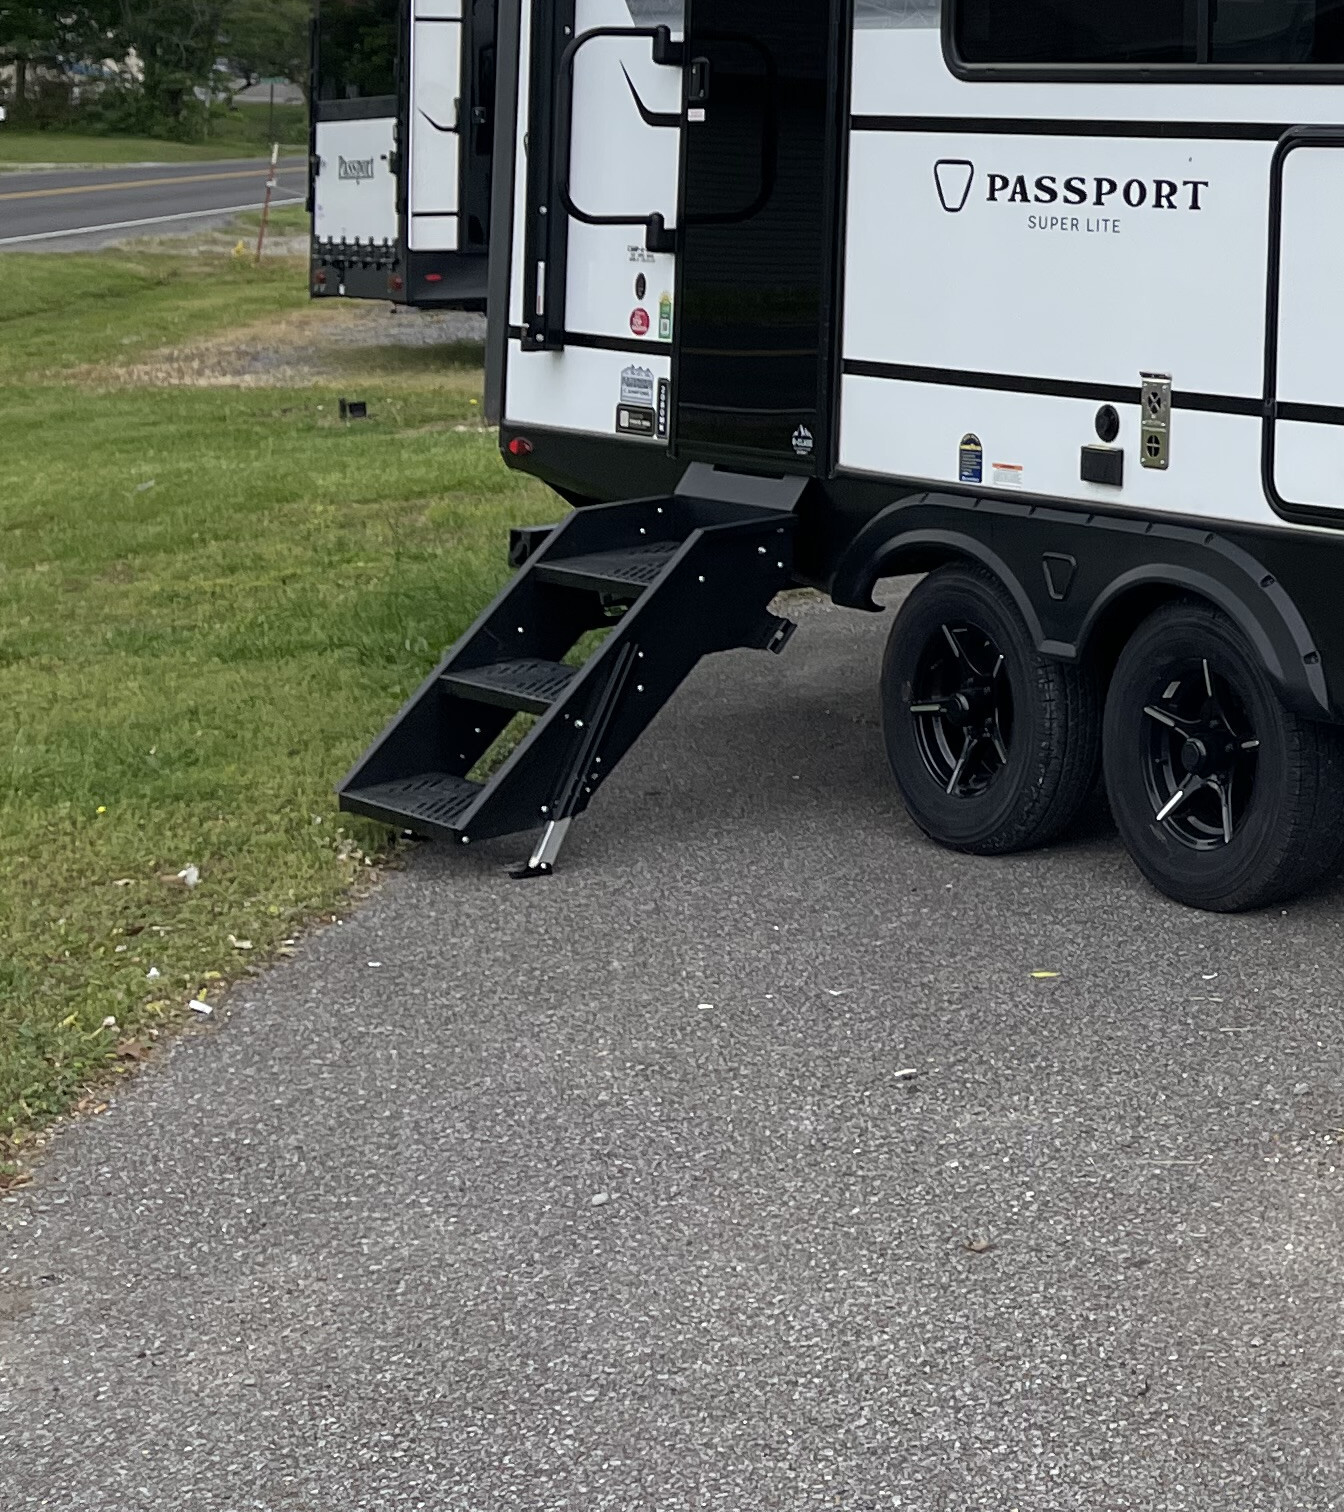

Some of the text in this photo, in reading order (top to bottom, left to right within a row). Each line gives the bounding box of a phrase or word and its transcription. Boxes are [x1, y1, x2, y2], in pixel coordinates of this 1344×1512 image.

[986, 173, 1209, 211] PASSPORT
[1027, 215, 1121, 234] SUPER LITE
